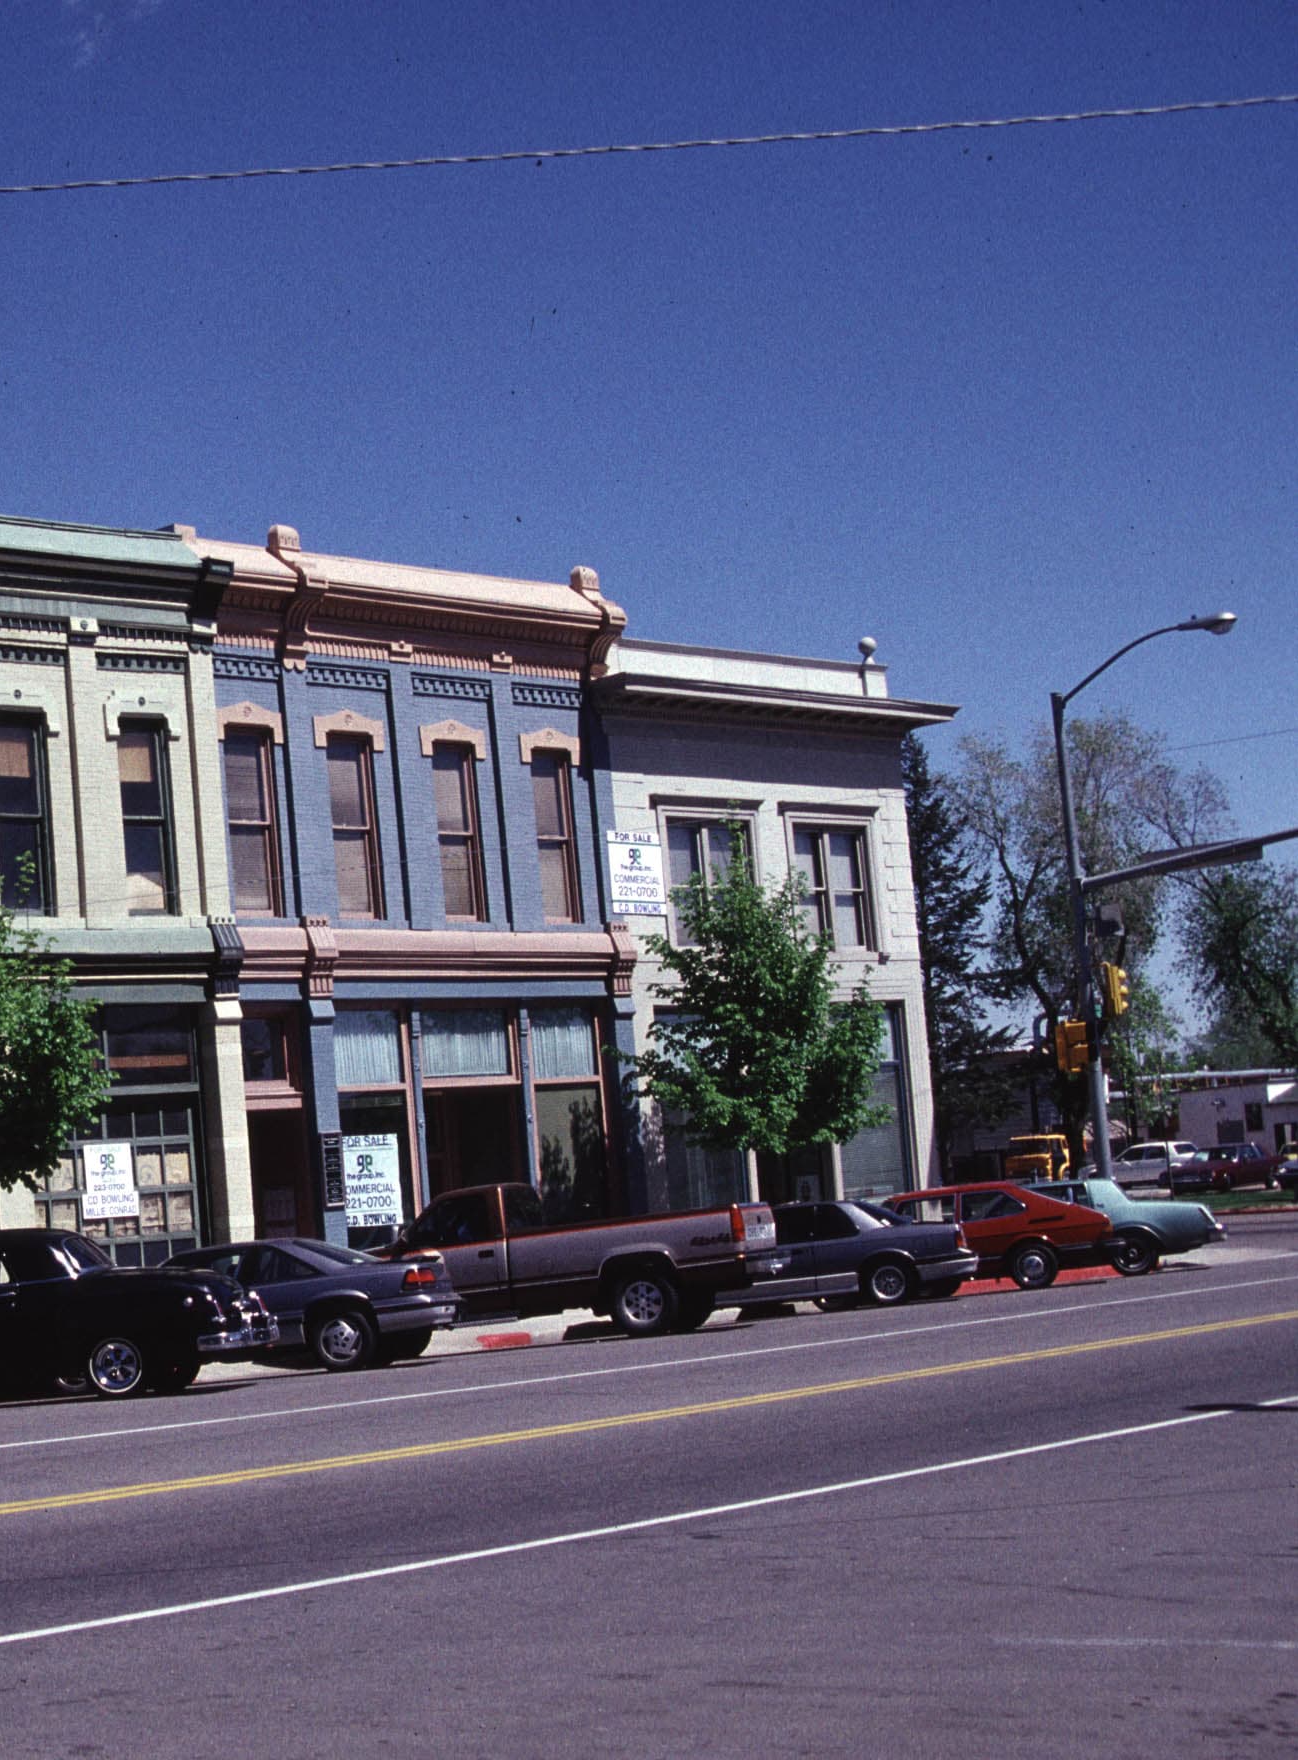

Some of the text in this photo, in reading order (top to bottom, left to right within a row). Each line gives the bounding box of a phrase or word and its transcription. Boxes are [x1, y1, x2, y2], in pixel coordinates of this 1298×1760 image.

[614, 832, 652, 843] FOR SALE
[614, 874, 660, 885] COMMERCIAL
[618, 886, 658, 898] 221-0700
[634, 904, 662, 914] BOWLING
[364, 1135, 388, 1146] SALE
[345, 1184, 396, 1196] OMMERCIAL
[101, 1193, 135, 1204] BOWLING
[345, 1196, 392, 1209] 221-0700
[363, 1213, 397, 1225] BOWLING
